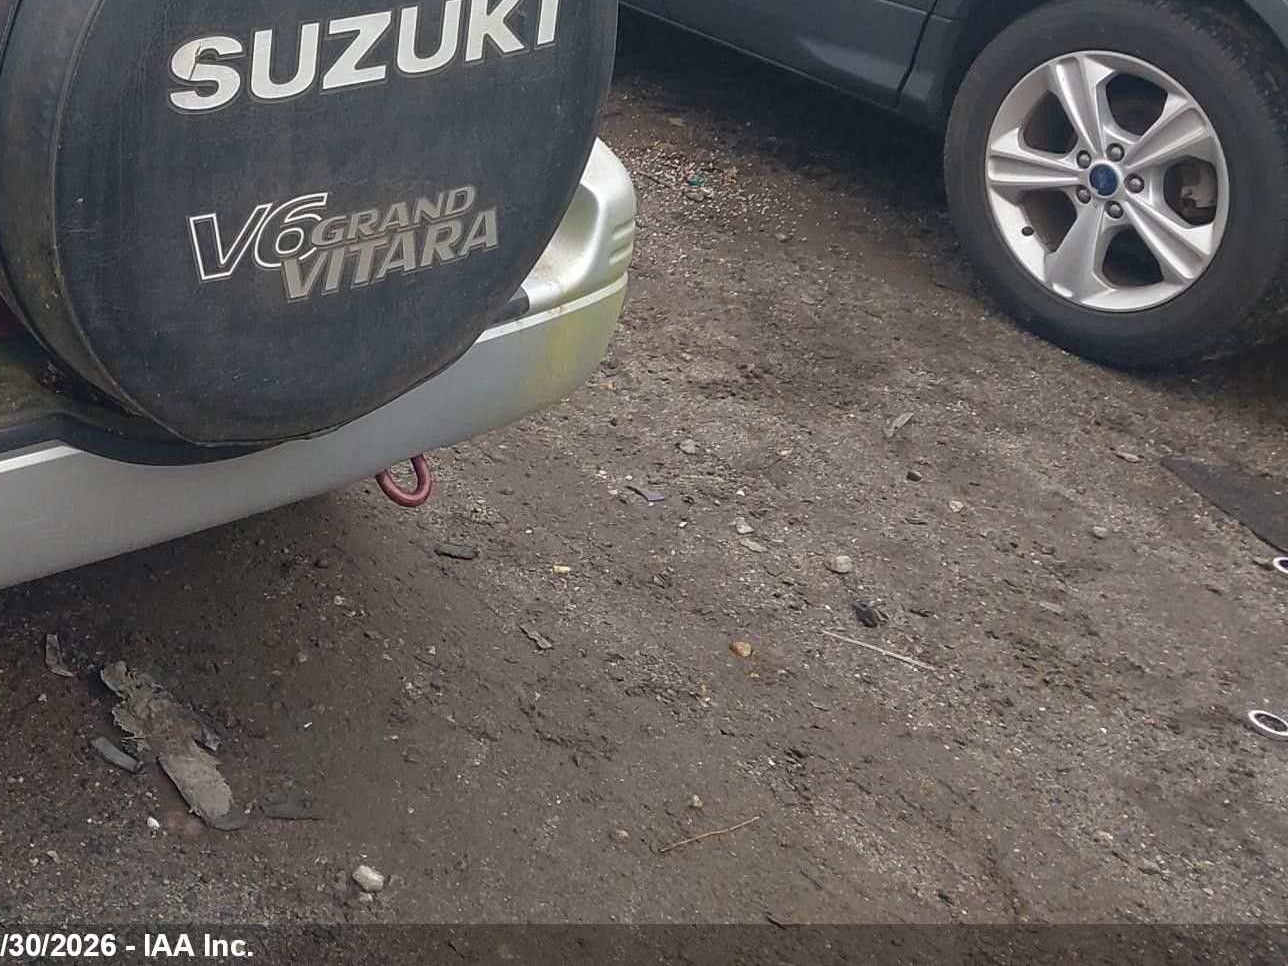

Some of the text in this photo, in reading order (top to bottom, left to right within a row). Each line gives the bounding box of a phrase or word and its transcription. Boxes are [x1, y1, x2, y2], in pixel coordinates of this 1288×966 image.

[187, 192, 328, 281] V6
[281, 207, 500, 302] VITARA
[312, 185, 477, 246] GRAND
